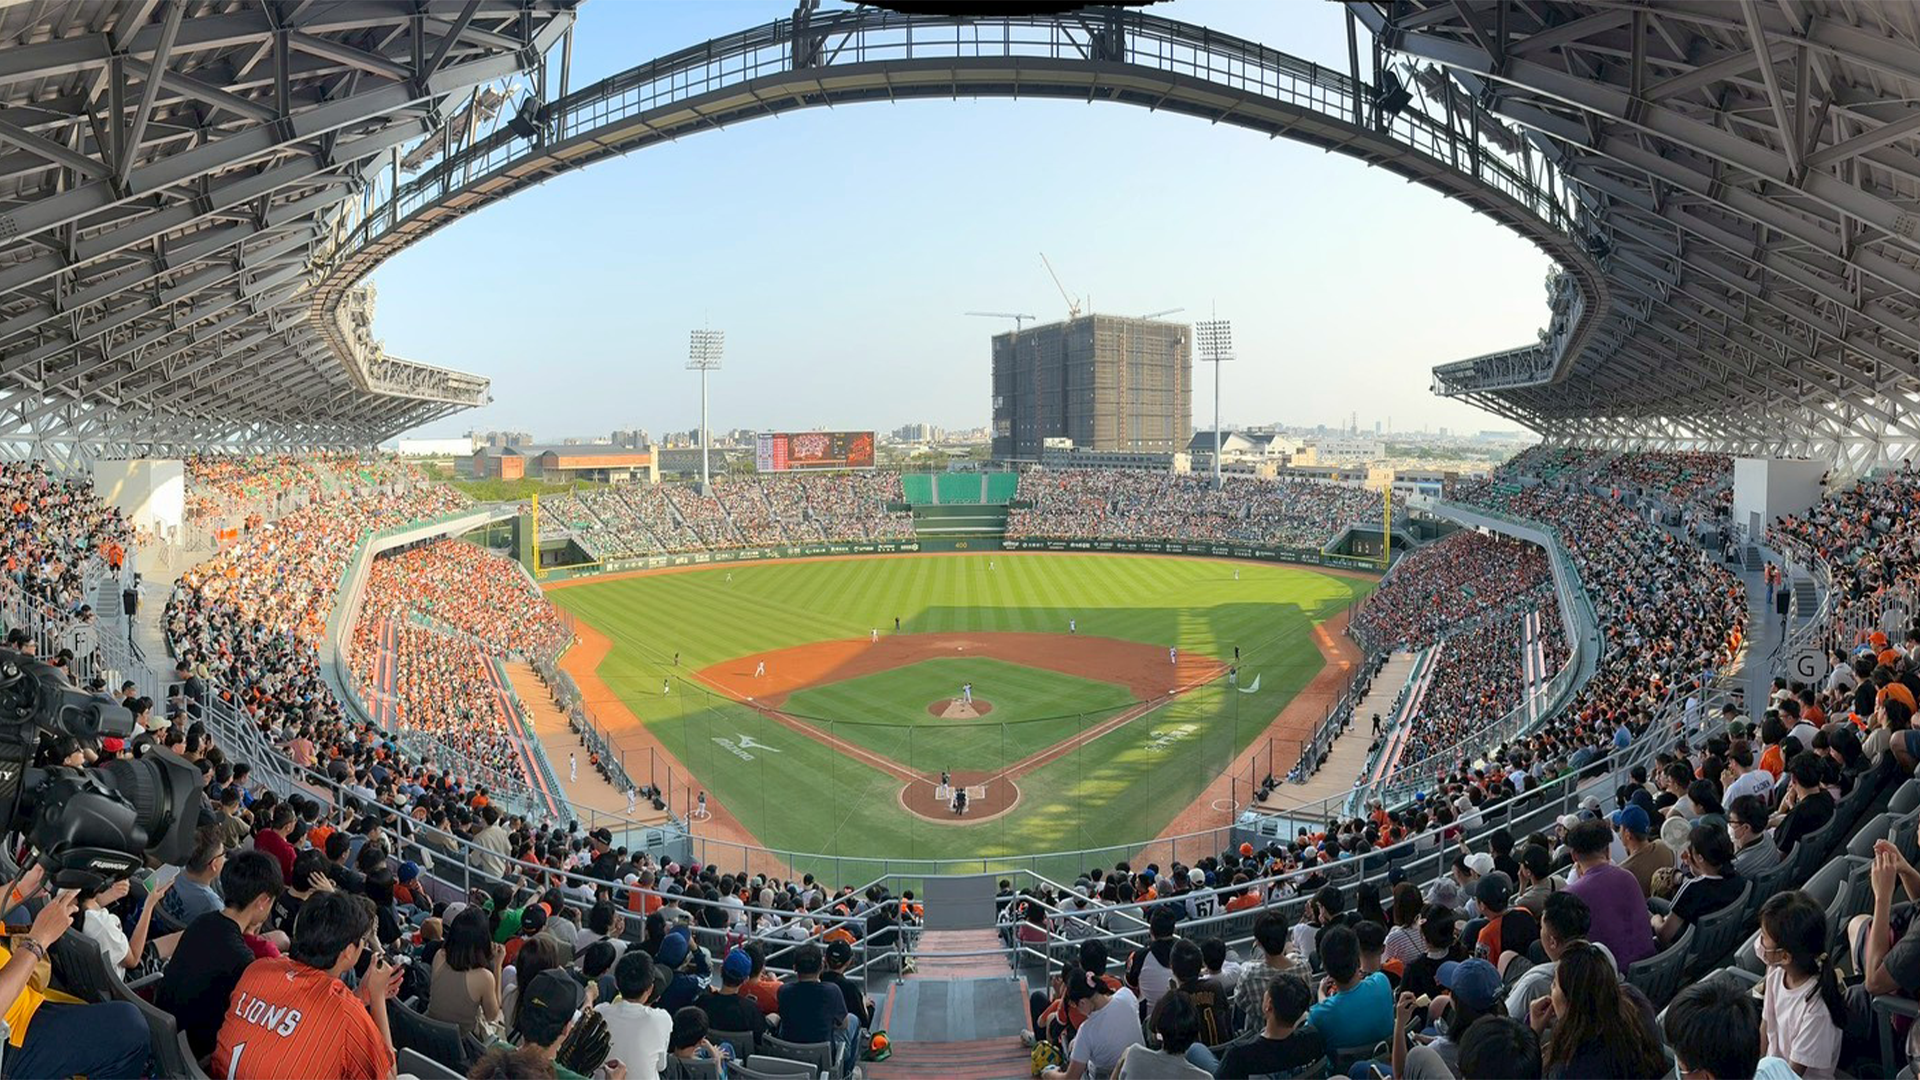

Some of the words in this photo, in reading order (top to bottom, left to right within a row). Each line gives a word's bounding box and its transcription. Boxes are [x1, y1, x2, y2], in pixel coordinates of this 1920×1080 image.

[955, 541, 968, 549] 400
[75, 632, 86, 652] F
[1797, 655, 1815, 677] G
[90, 860, 130, 871] FUJINON
[1195, 898, 1214, 917] 67
[235, 992, 302, 1038] LIONS
